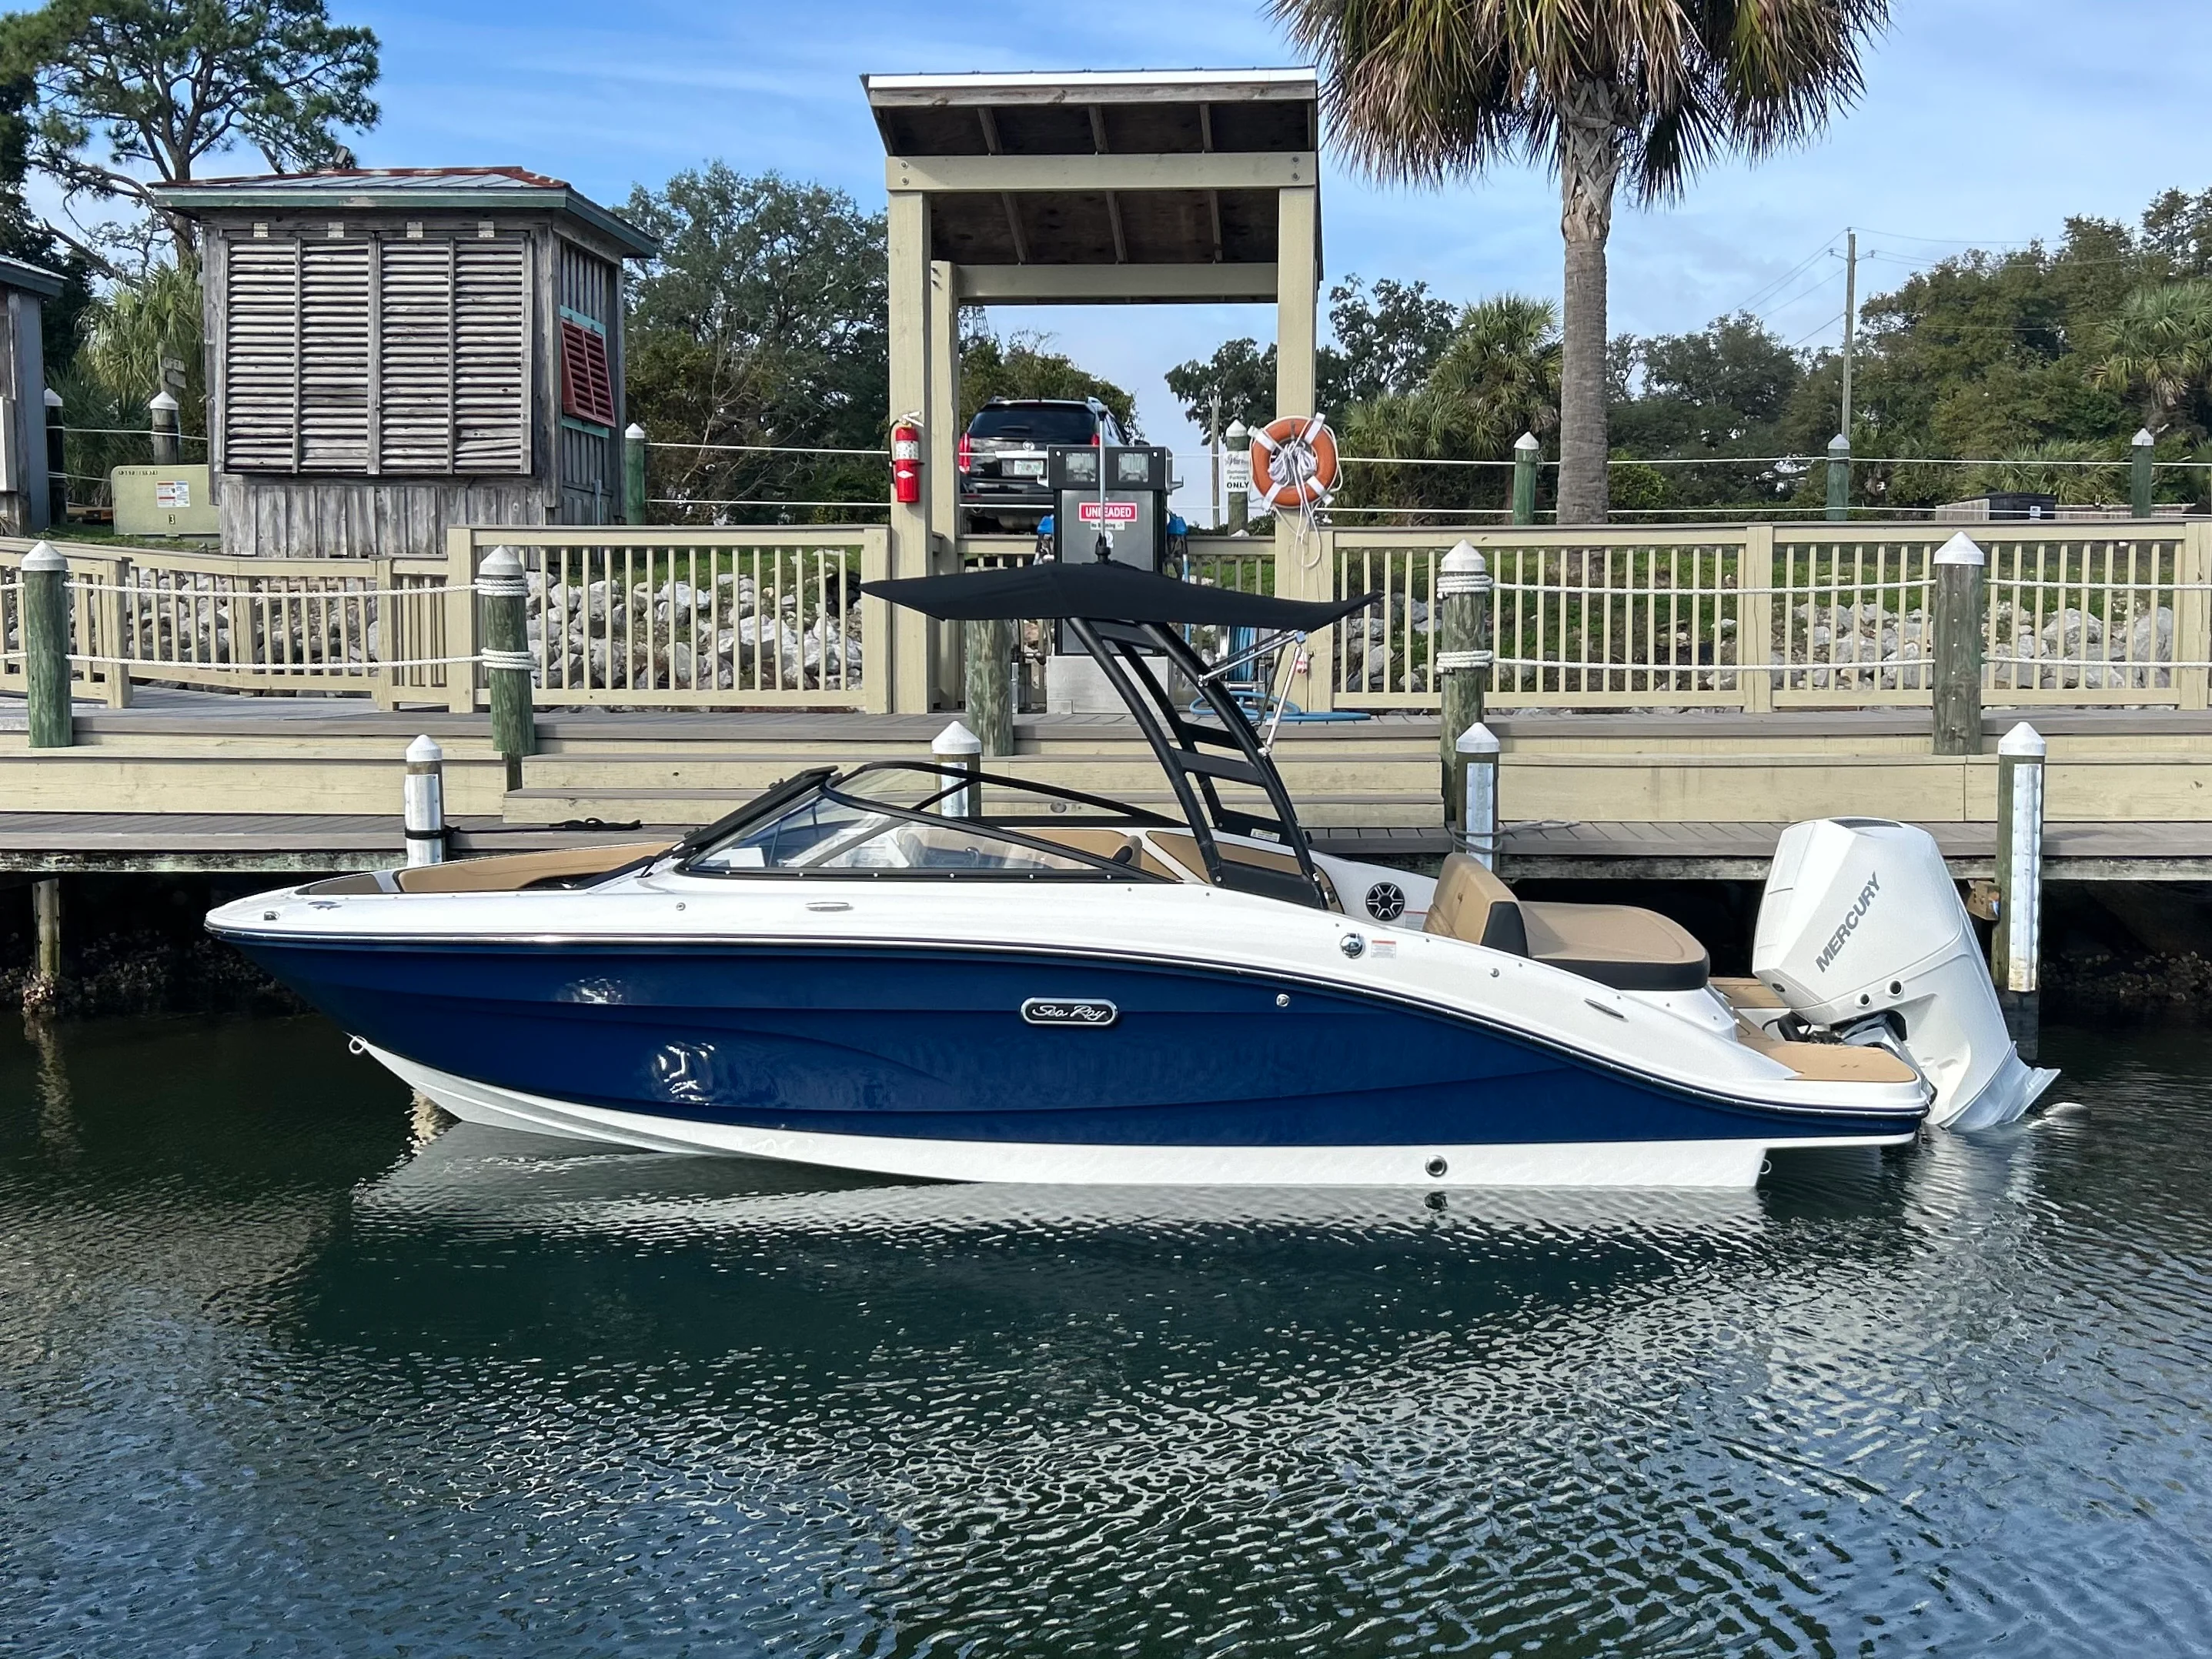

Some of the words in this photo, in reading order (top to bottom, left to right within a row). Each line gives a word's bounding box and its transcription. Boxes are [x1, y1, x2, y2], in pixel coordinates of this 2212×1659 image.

[169, 515, 175, 524] 3
[1815, 870, 1880, 973] MERCURY
[1031, 1005, 1068, 1017] Sea
[1070, 1005, 1108, 1021] Ray
